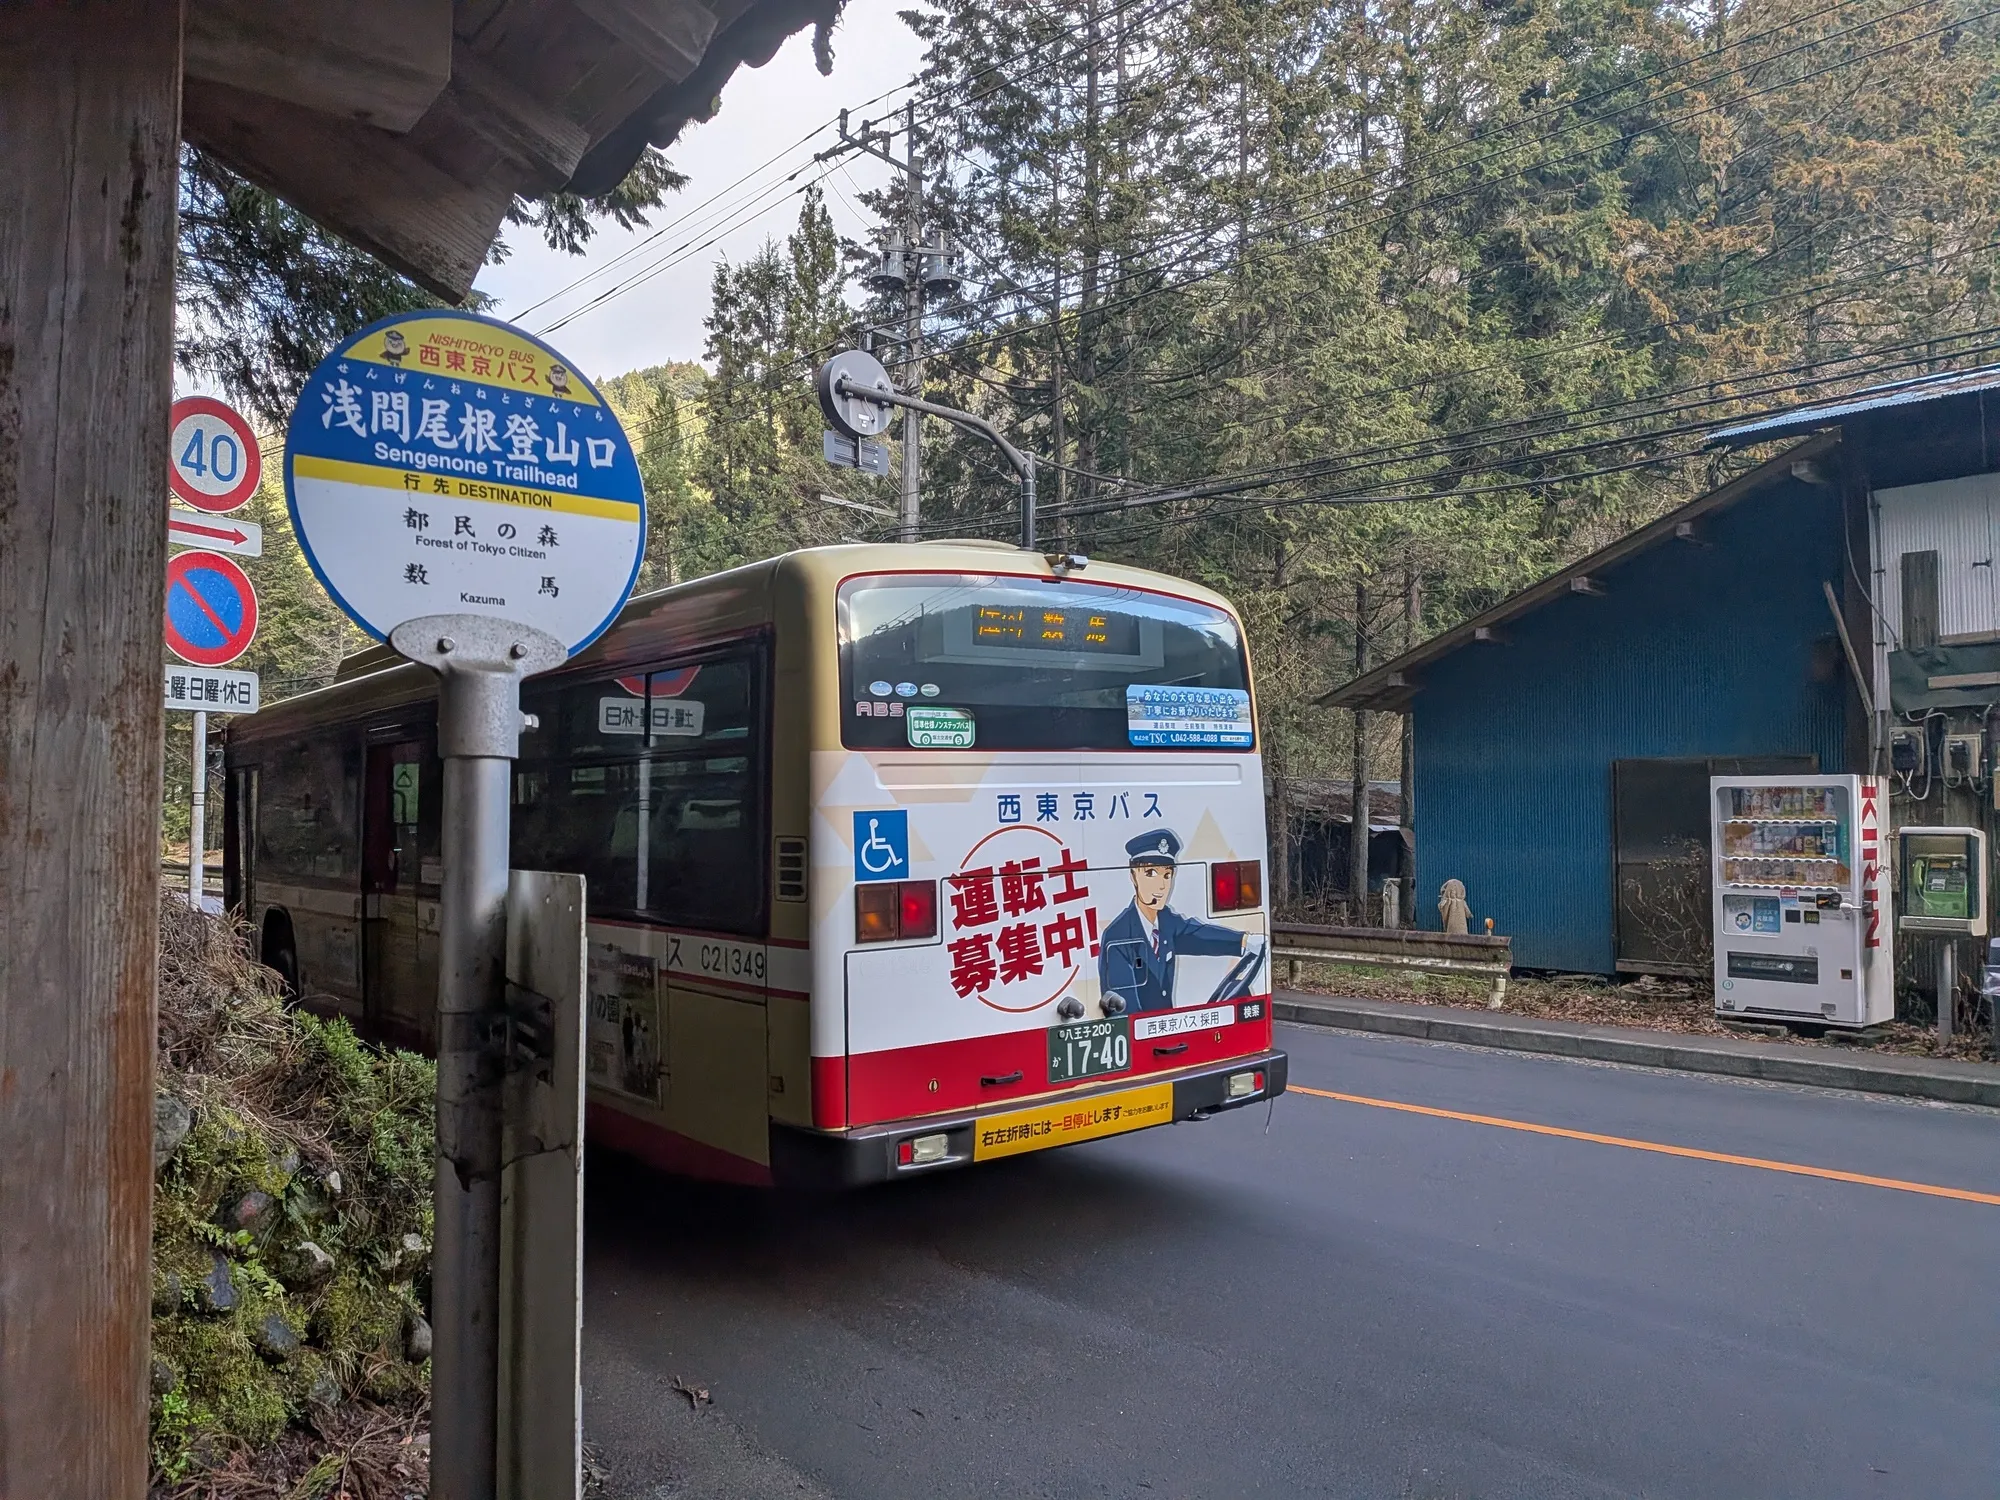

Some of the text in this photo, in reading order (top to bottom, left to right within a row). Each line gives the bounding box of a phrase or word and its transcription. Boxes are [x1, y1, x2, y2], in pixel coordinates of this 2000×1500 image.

[419, 344, 540, 387] 西東京バス
[428, 332, 535, 365] NISHITOKYO BUS
[321, 378, 617, 469] 浅間尾根登山口
[180, 428, 238, 482] 40
[374, 442, 578, 489] Sengenone Trailhead
[404, 472, 552, 508] 行先 DESTINATION
[403, 507, 560, 548] 都民の森
[415, 534, 547, 560] Forest of Tokyo Citizen
[403, 562, 560, 599] 数馬
[460, 591, 506, 607] Kazuma
[856, 701, 904, 717] ABS
[1149, 733, 1167, 744] TSC
[997, 792, 1163, 823] 西東京バス
[1861, 786, 1880, 948] KIRIN
[948, 846, 1089, 931] 運転士
[701, 944, 765, 979] C21349
[1147, 1011, 1220, 1037] 西東京バス 採用
[1243, 1004, 1260, 1019] 検索
[1052, 1056, 1062, 1068] か
[1067, 1034, 1128, 1077] 17-40
[981, 1105, 1122, 1148] 右左折時には一旦停止します
